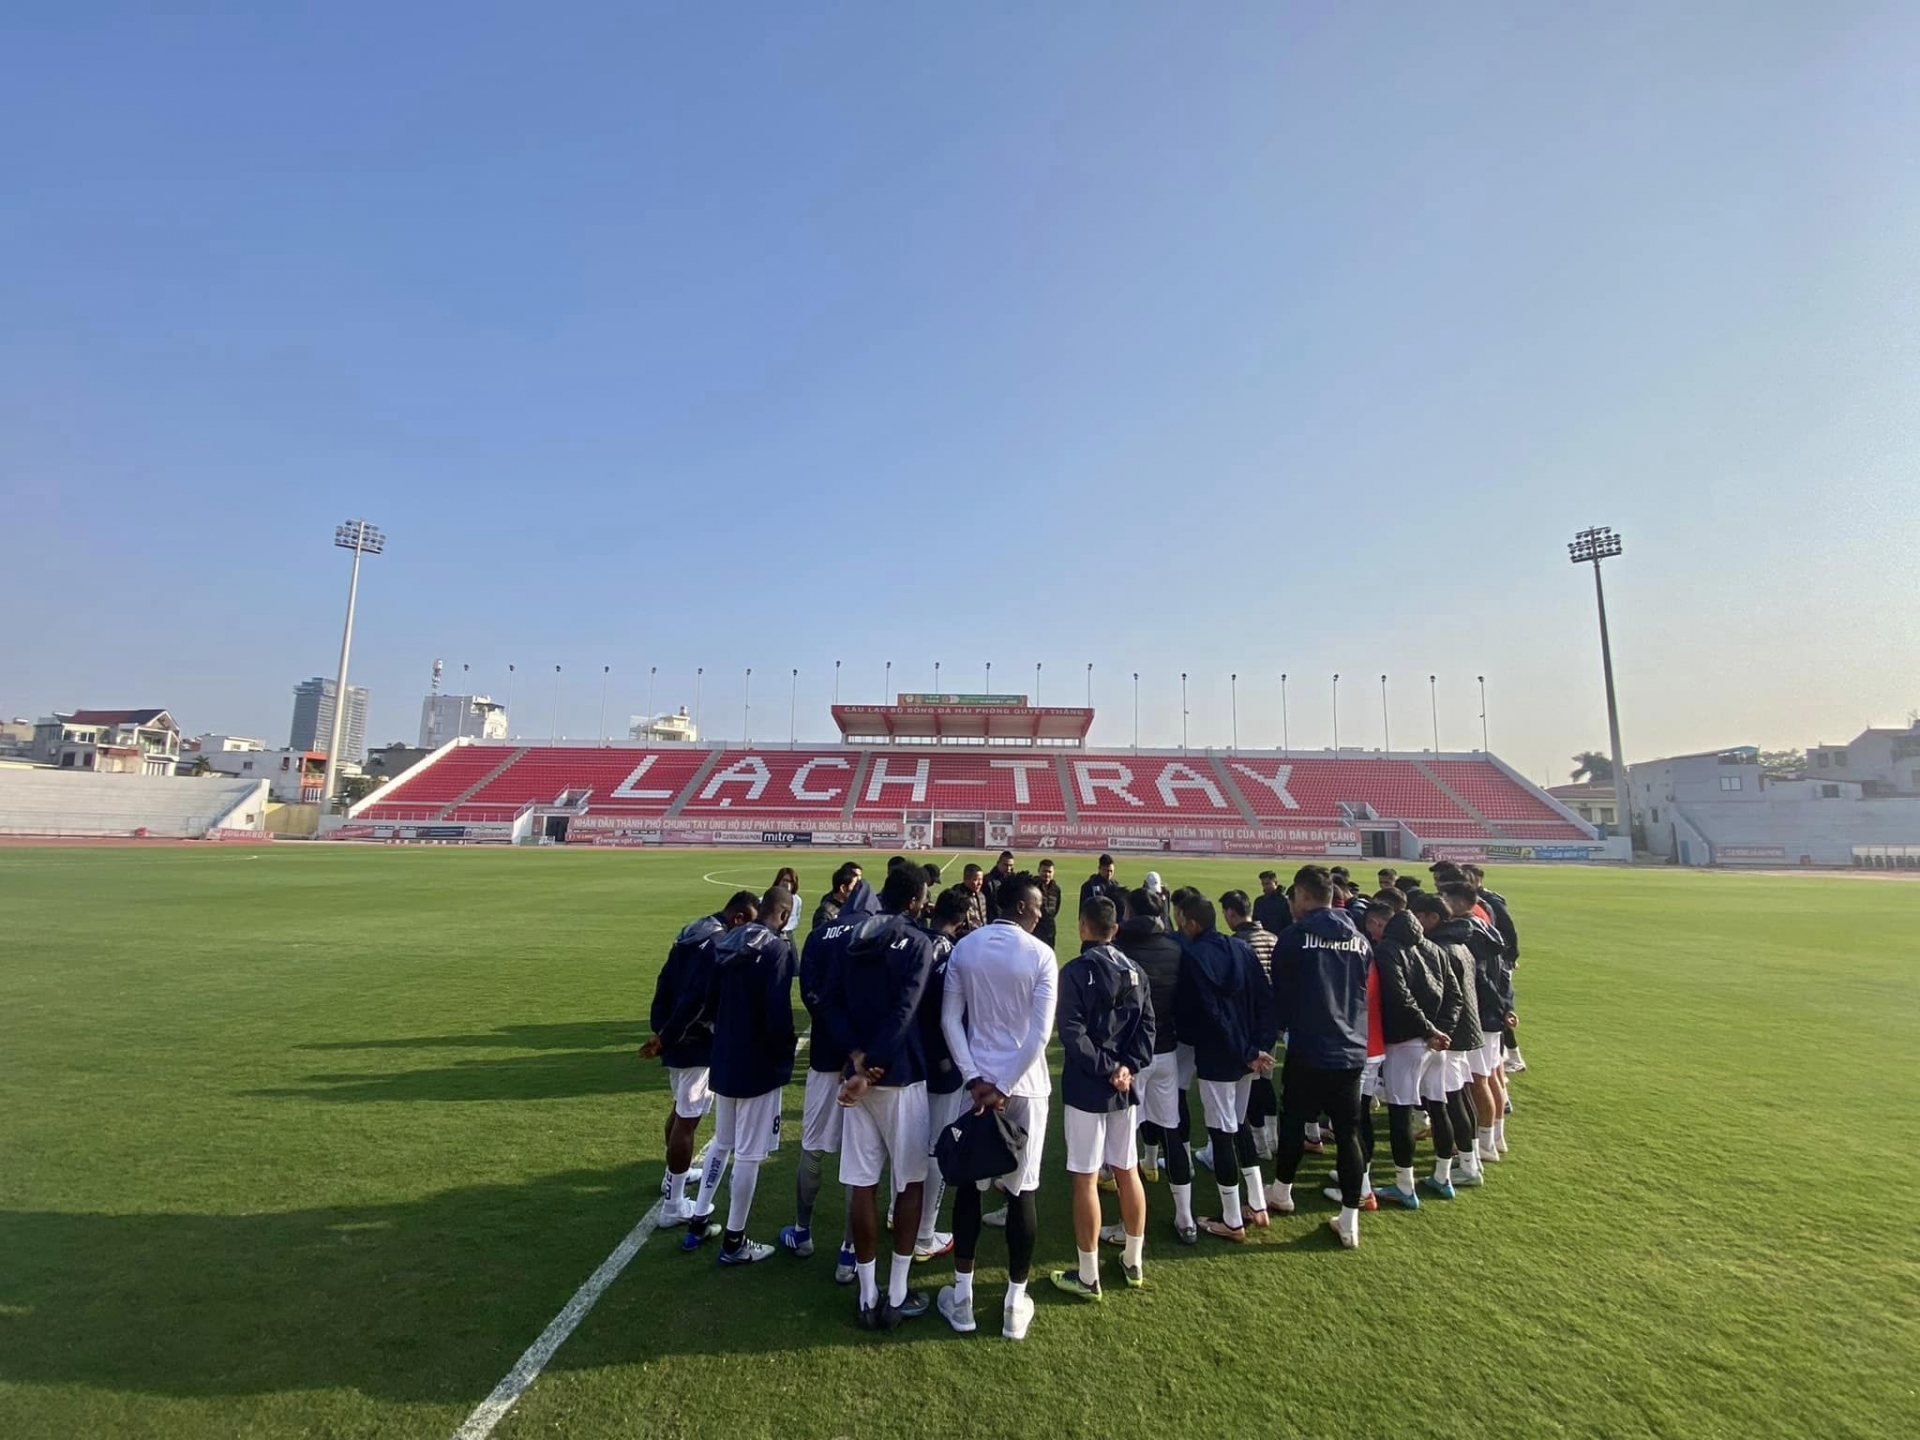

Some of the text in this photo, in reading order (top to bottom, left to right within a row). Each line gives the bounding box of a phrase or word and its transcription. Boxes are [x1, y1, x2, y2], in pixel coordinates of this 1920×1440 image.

[663, 818, 690, 830] CHUNG
[690, 819, 708, 830] TAY
[763, 832, 795, 842] mitre
[1198, 827, 1214, 839] TIN
[772, 1115, 781, 1135] 8
